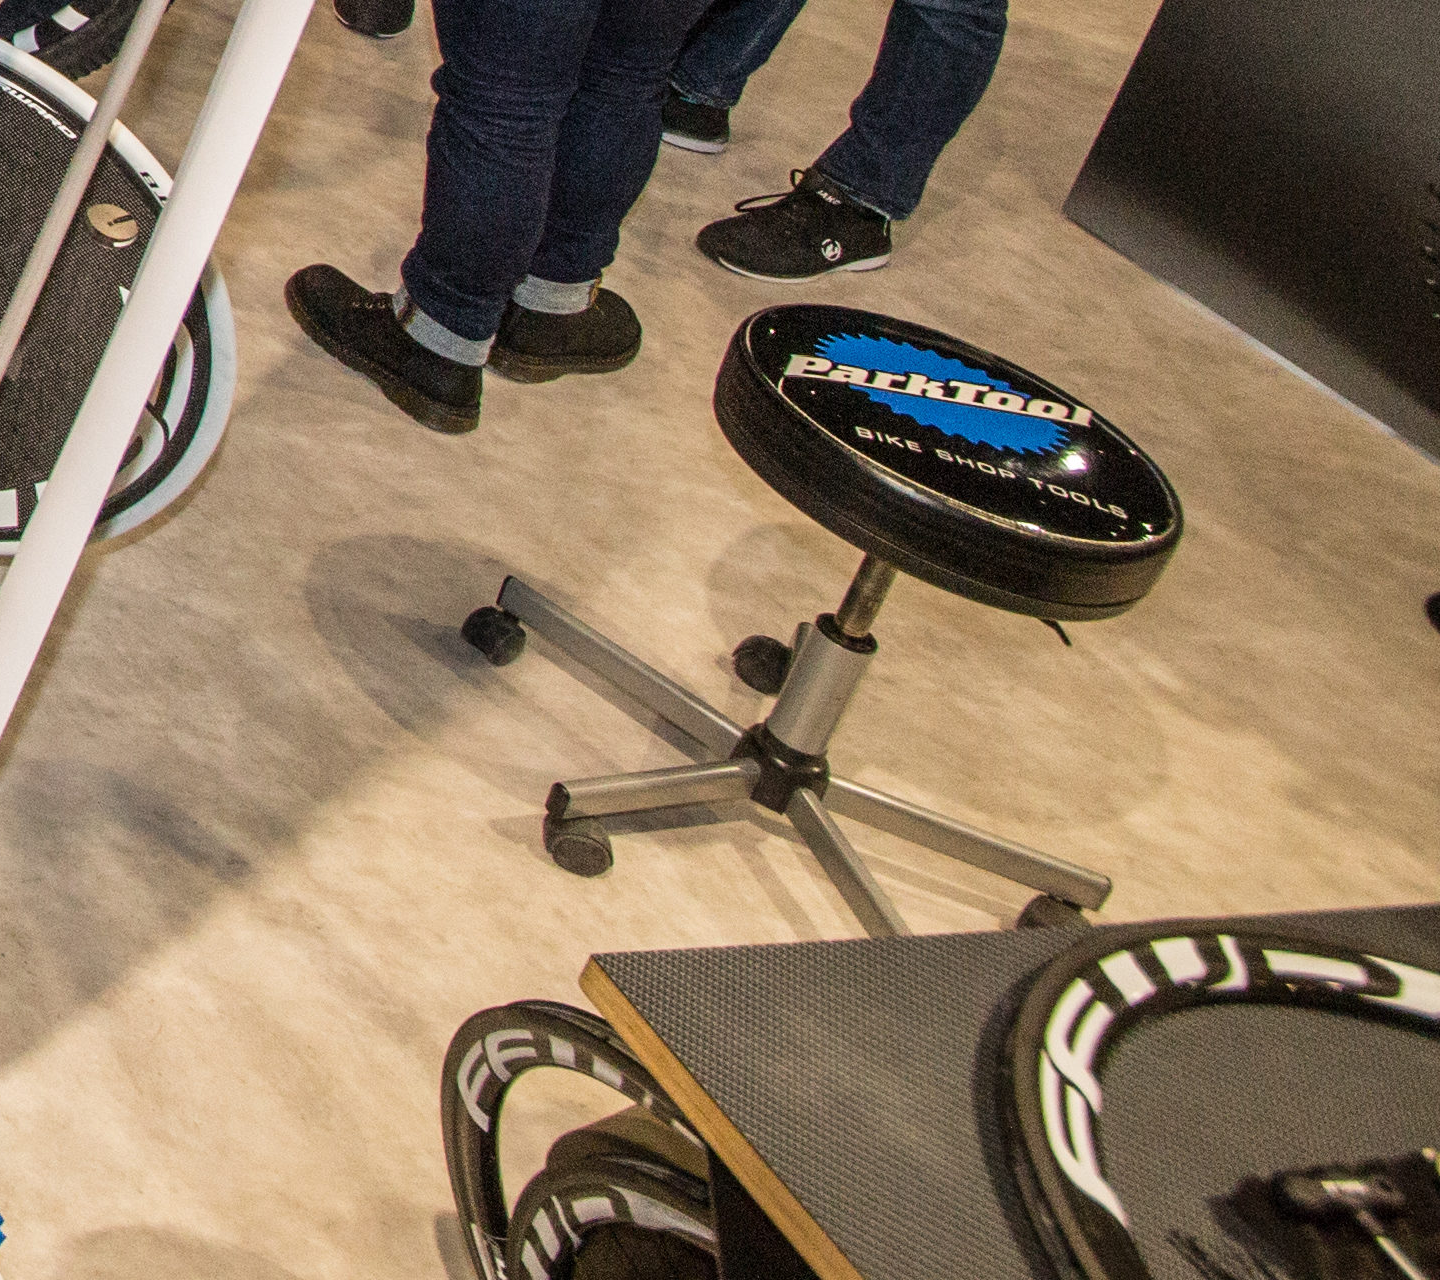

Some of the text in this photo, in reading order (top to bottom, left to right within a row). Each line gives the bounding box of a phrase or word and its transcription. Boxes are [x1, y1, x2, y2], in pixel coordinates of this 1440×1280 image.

[784, 354, 1092, 427] ParkTool
[855, 425, 1130, 520] BIKE SHOP TOOLS
